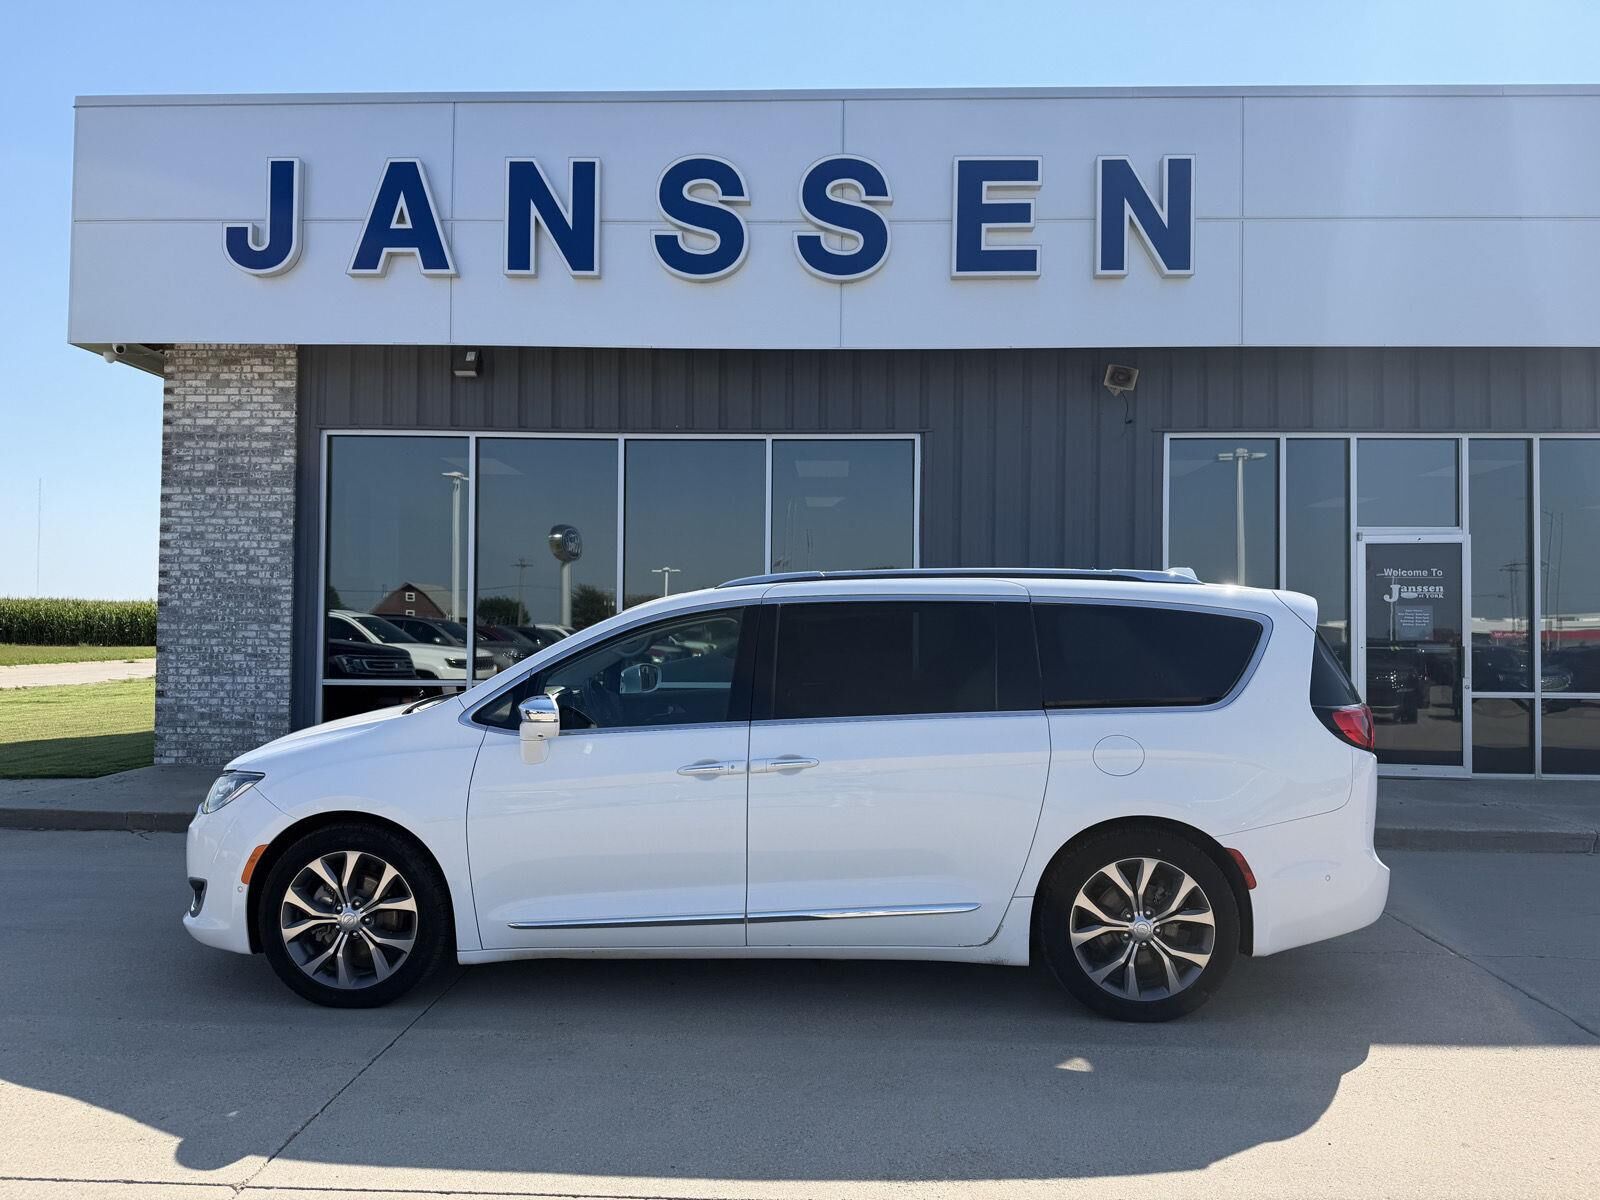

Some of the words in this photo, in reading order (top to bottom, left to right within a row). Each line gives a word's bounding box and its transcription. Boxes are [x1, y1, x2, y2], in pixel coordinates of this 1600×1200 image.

[222, 154, 1196, 281] JANSSEN
[1383, 568, 1428, 577] Welcome
[1430, 568, 1443, 577] To
[1383, 584, 1444, 602] Janssen
